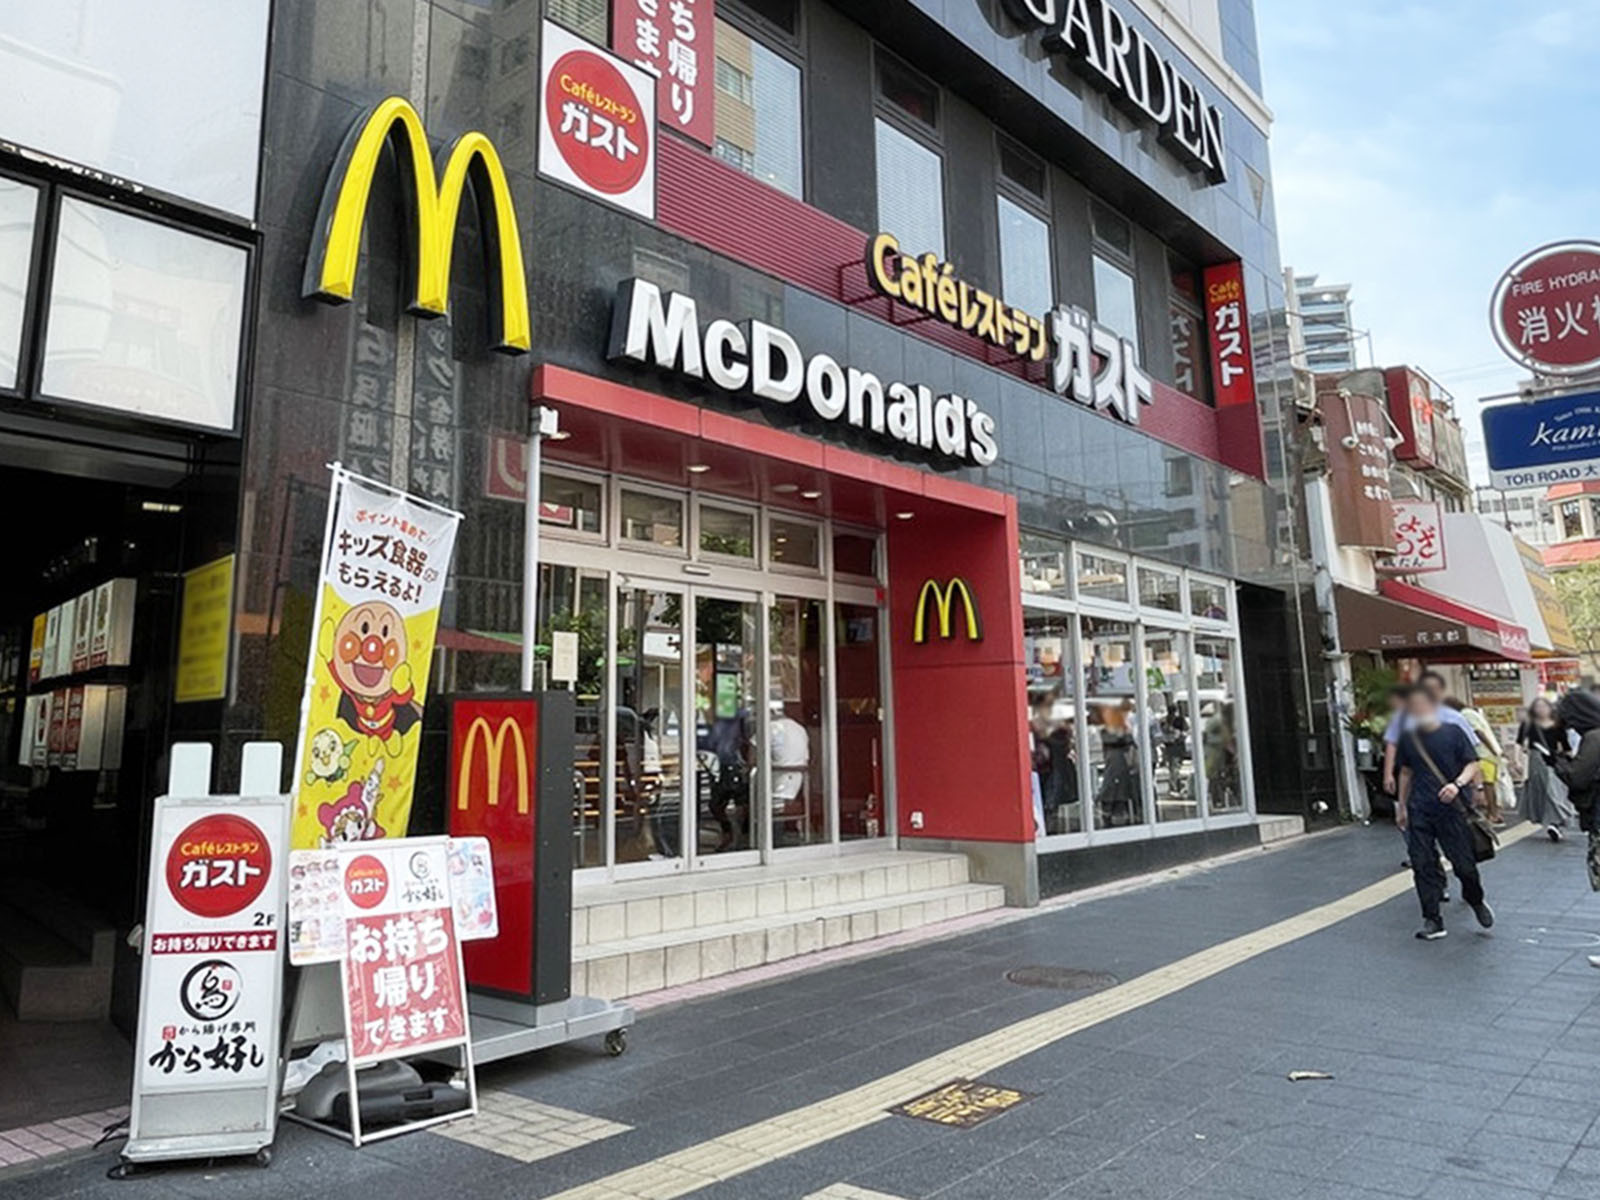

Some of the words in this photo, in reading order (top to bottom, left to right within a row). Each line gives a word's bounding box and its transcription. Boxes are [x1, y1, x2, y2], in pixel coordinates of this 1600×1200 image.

[667, 0, 698, 125] ち帰り
[560, 102, 640, 161] ガスト
[1512, 279, 1544, 297] FIRE
[872, 232, 1047, 362] Caféレストラン
[1050, 303, 1154, 425] ガスト
[1517, 295, 1600, 345] 消火
[1215, 301, 1245, 387] ガスト
[625, 277, 998, 467] McDonald's
[1530, 421, 1600, 447] kam
[1505, 472, 1534, 485] TOR
[1538, 467, 1580, 482] ROAD
[1584, 464, 1598, 477] 大
[338, 529, 428, 578] キッズ食器
[180, 841, 260, 856] Caféレストラン
[179, 859, 262, 888] ガスト
[350, 876, 385, 895] ガスト
[253, 912, 275, 927] 2F
[349, 914, 450, 964] お持ち
[152, 933, 274, 952] お持ち帰りできます
[372, 961, 436, 1009] 帰り
[364, 1006, 449, 1046] できます
[149, 1035, 264, 1074] から好し
